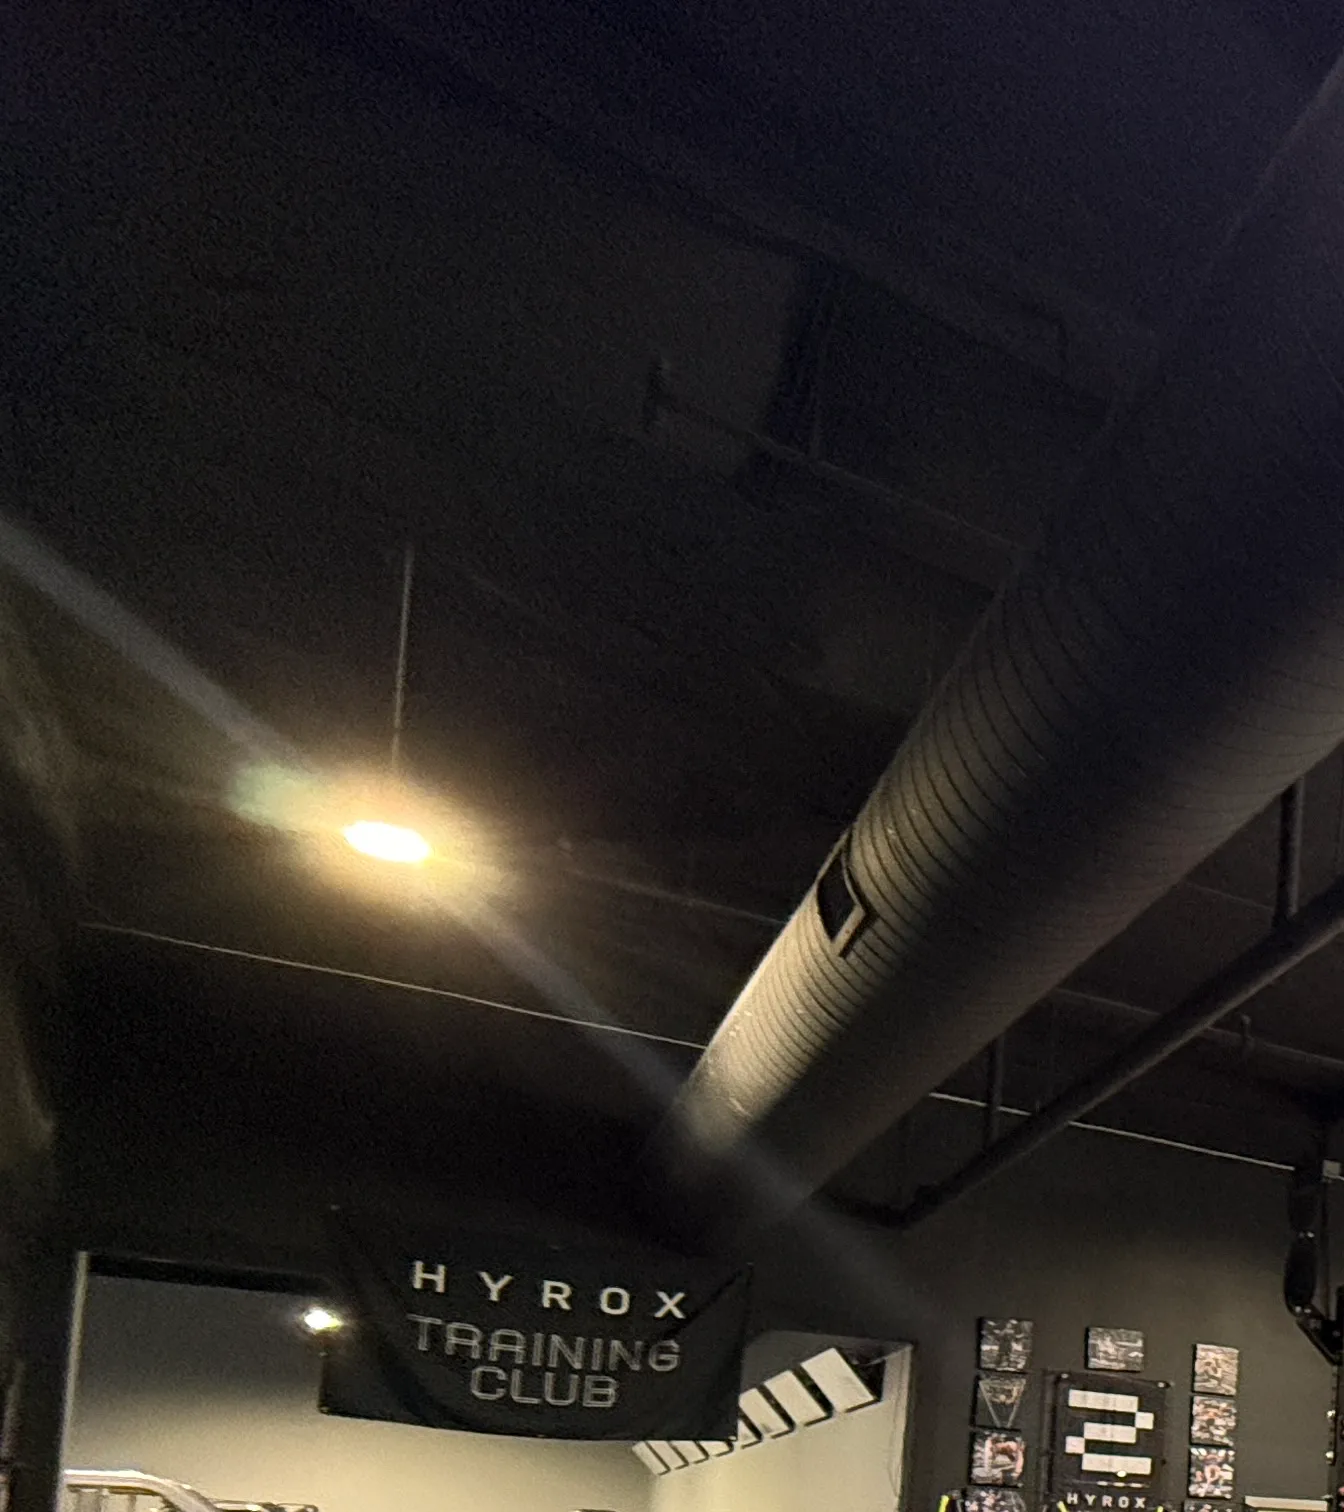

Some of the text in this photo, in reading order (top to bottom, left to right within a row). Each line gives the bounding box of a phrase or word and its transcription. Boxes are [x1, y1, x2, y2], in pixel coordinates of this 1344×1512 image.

[411, 1260, 686, 1319] HYROX
[408, 1313, 681, 1372] TRAINING
[470, 1365, 620, 1408] CLUB
[1066, 1492, 1147, 1509] HYROX
